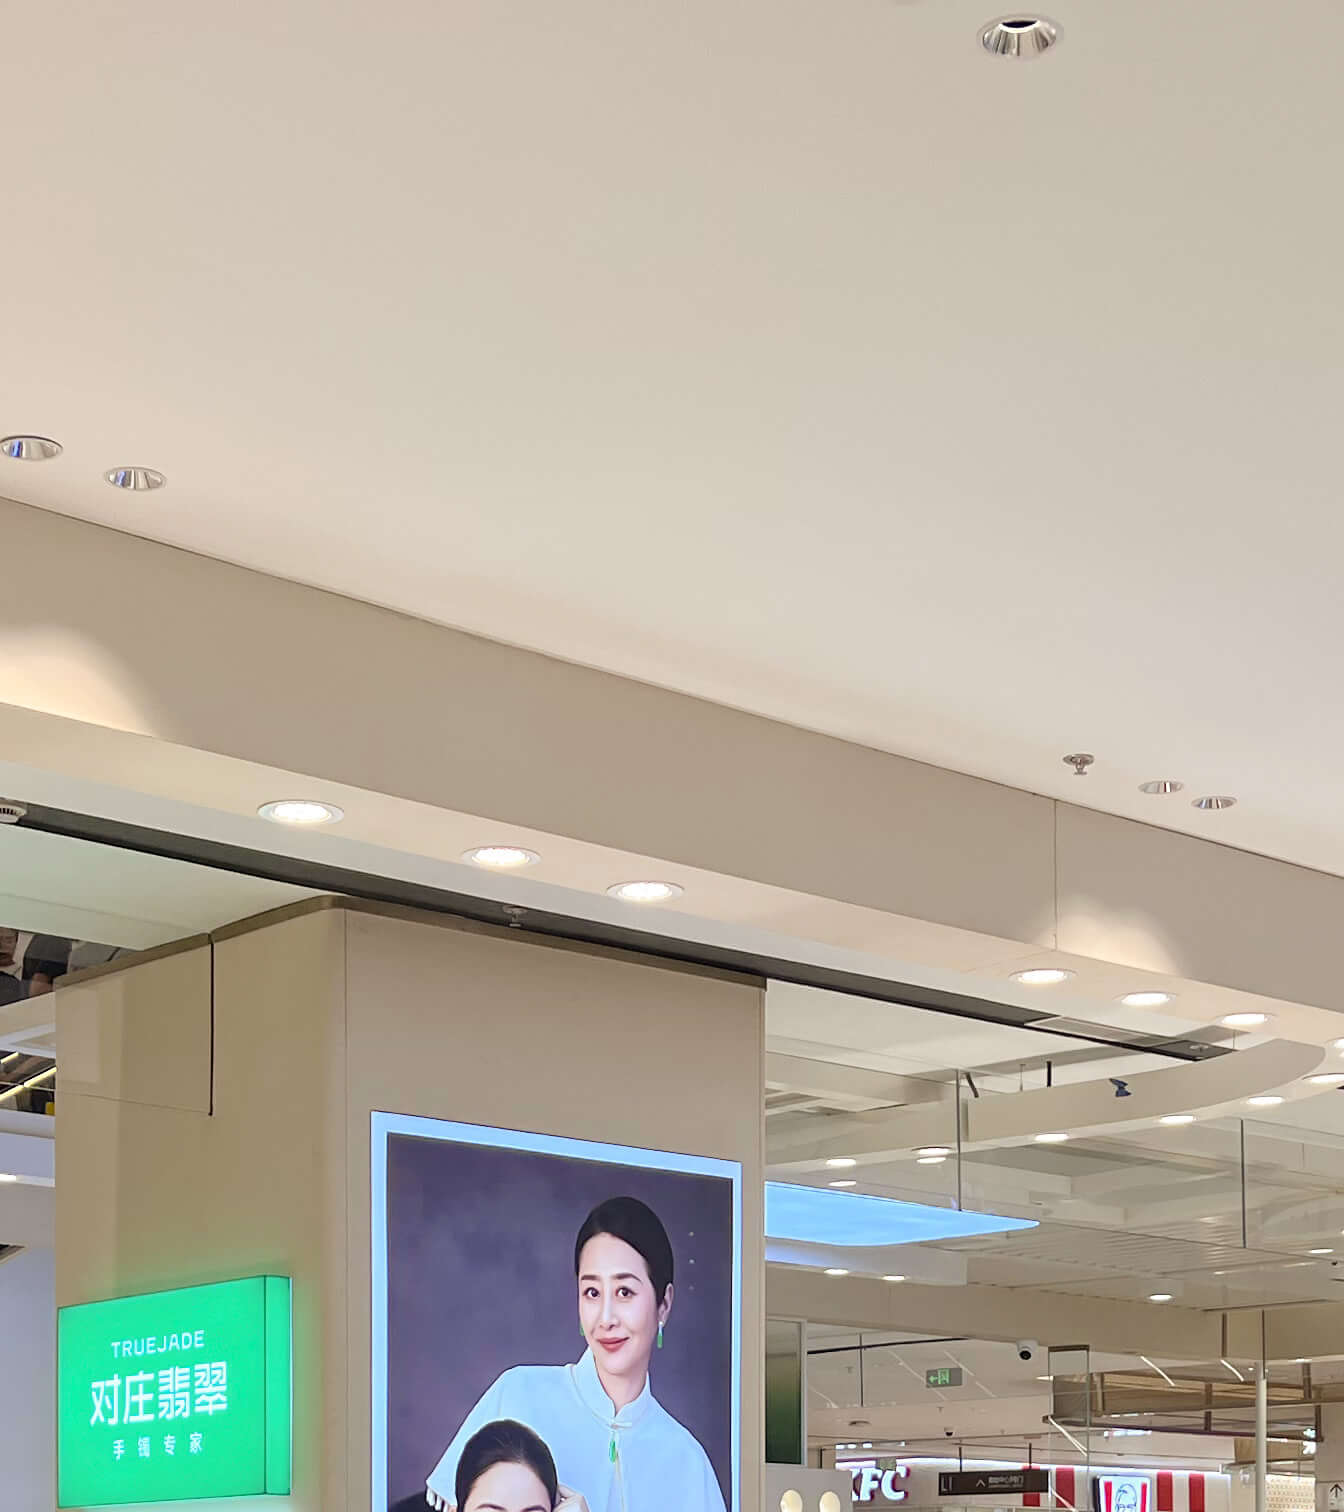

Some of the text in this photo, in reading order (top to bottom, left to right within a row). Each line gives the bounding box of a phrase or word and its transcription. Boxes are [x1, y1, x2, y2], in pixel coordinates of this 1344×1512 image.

[110, 1329, 206, 1359] TRUEJADE
[89, 1360, 229, 1428] 对庄翡翠
